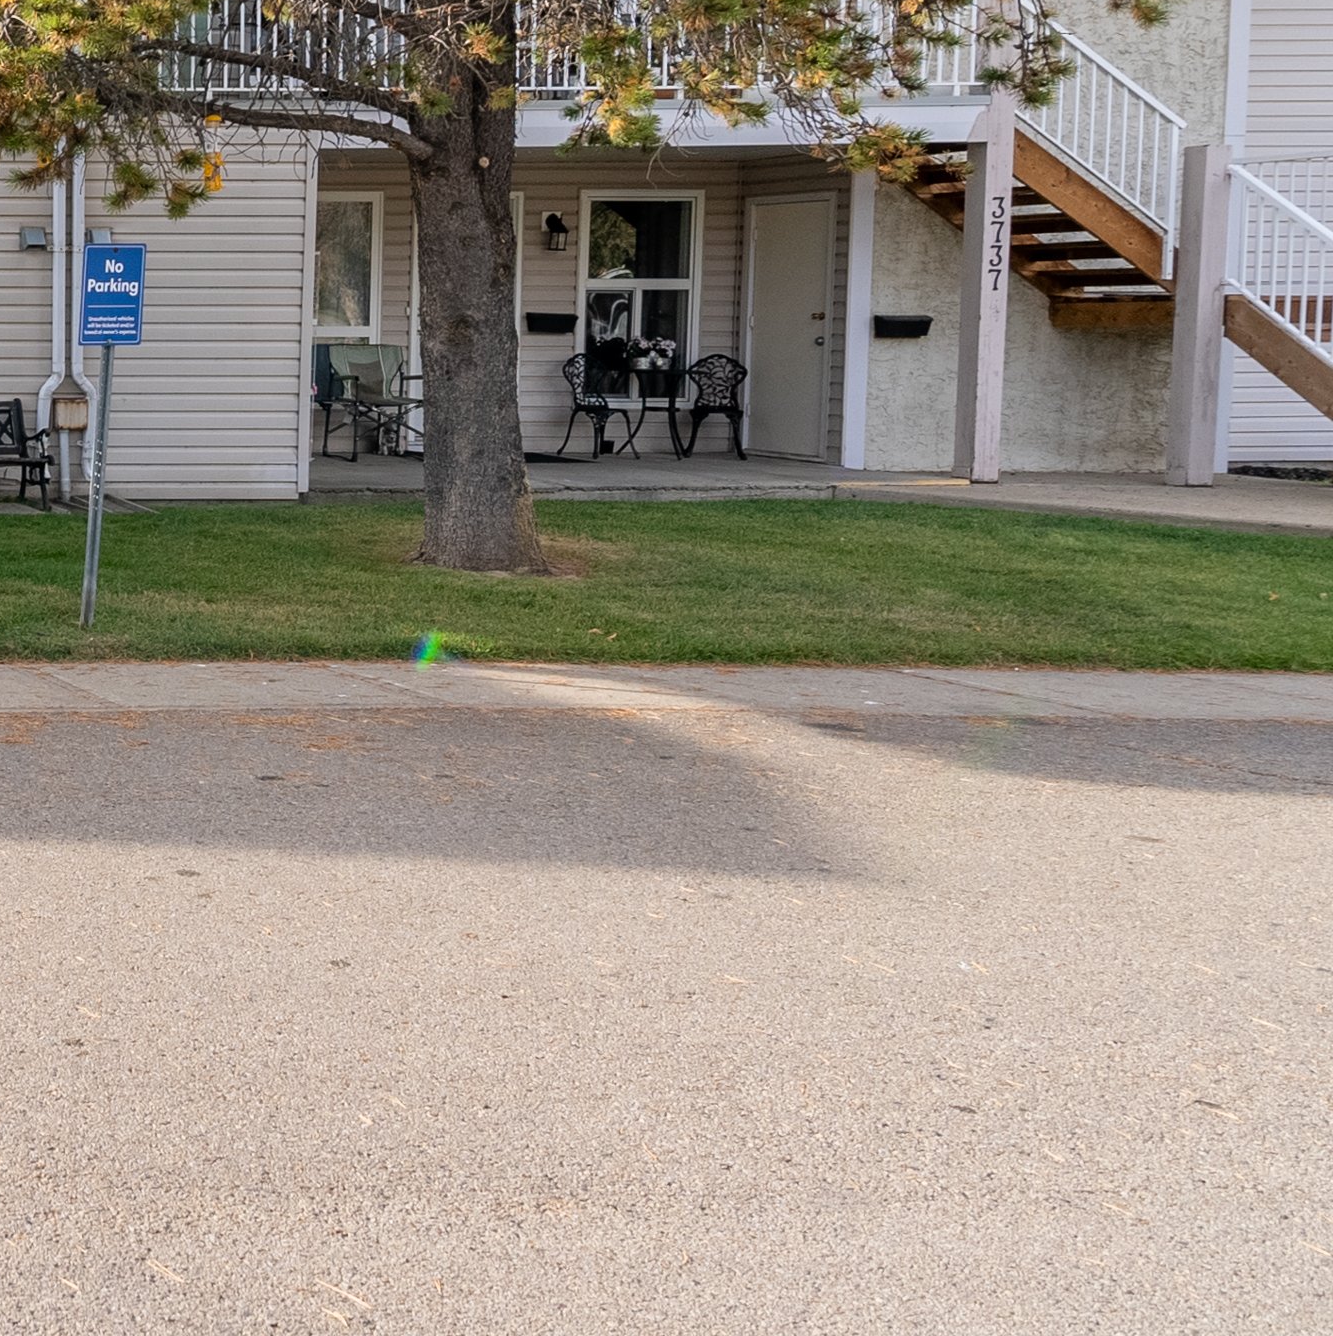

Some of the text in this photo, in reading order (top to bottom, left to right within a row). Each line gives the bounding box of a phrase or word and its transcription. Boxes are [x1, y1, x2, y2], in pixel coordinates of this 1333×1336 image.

[987, 196, 1006, 292] 3737
[105, 259, 124, 274] No
[87, 277, 139, 296] Parking
